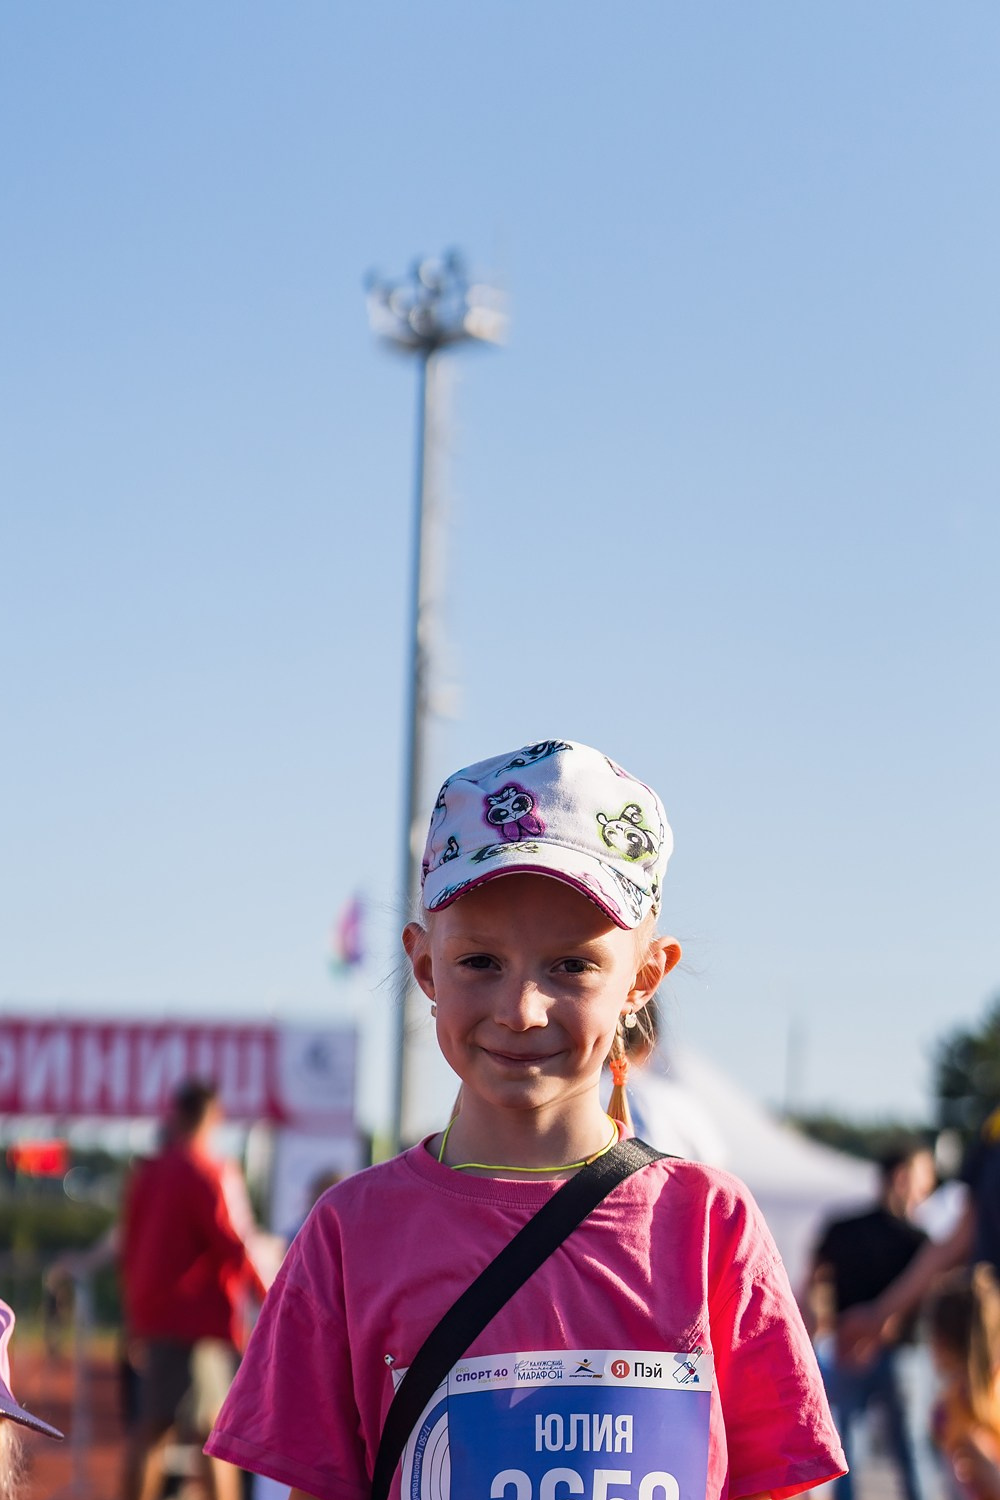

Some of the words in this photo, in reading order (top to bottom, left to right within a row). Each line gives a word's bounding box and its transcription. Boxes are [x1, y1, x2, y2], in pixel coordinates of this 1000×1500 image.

[456, 1370, 492, 1382] СПОРТ
[494, 1368, 508, 1378] 40
[517, 1371, 563, 1381] МАРАФОН
[634, 1362, 662, 1378] Пэй
[535, 1413, 633, 1453] ЮЛИЯ
